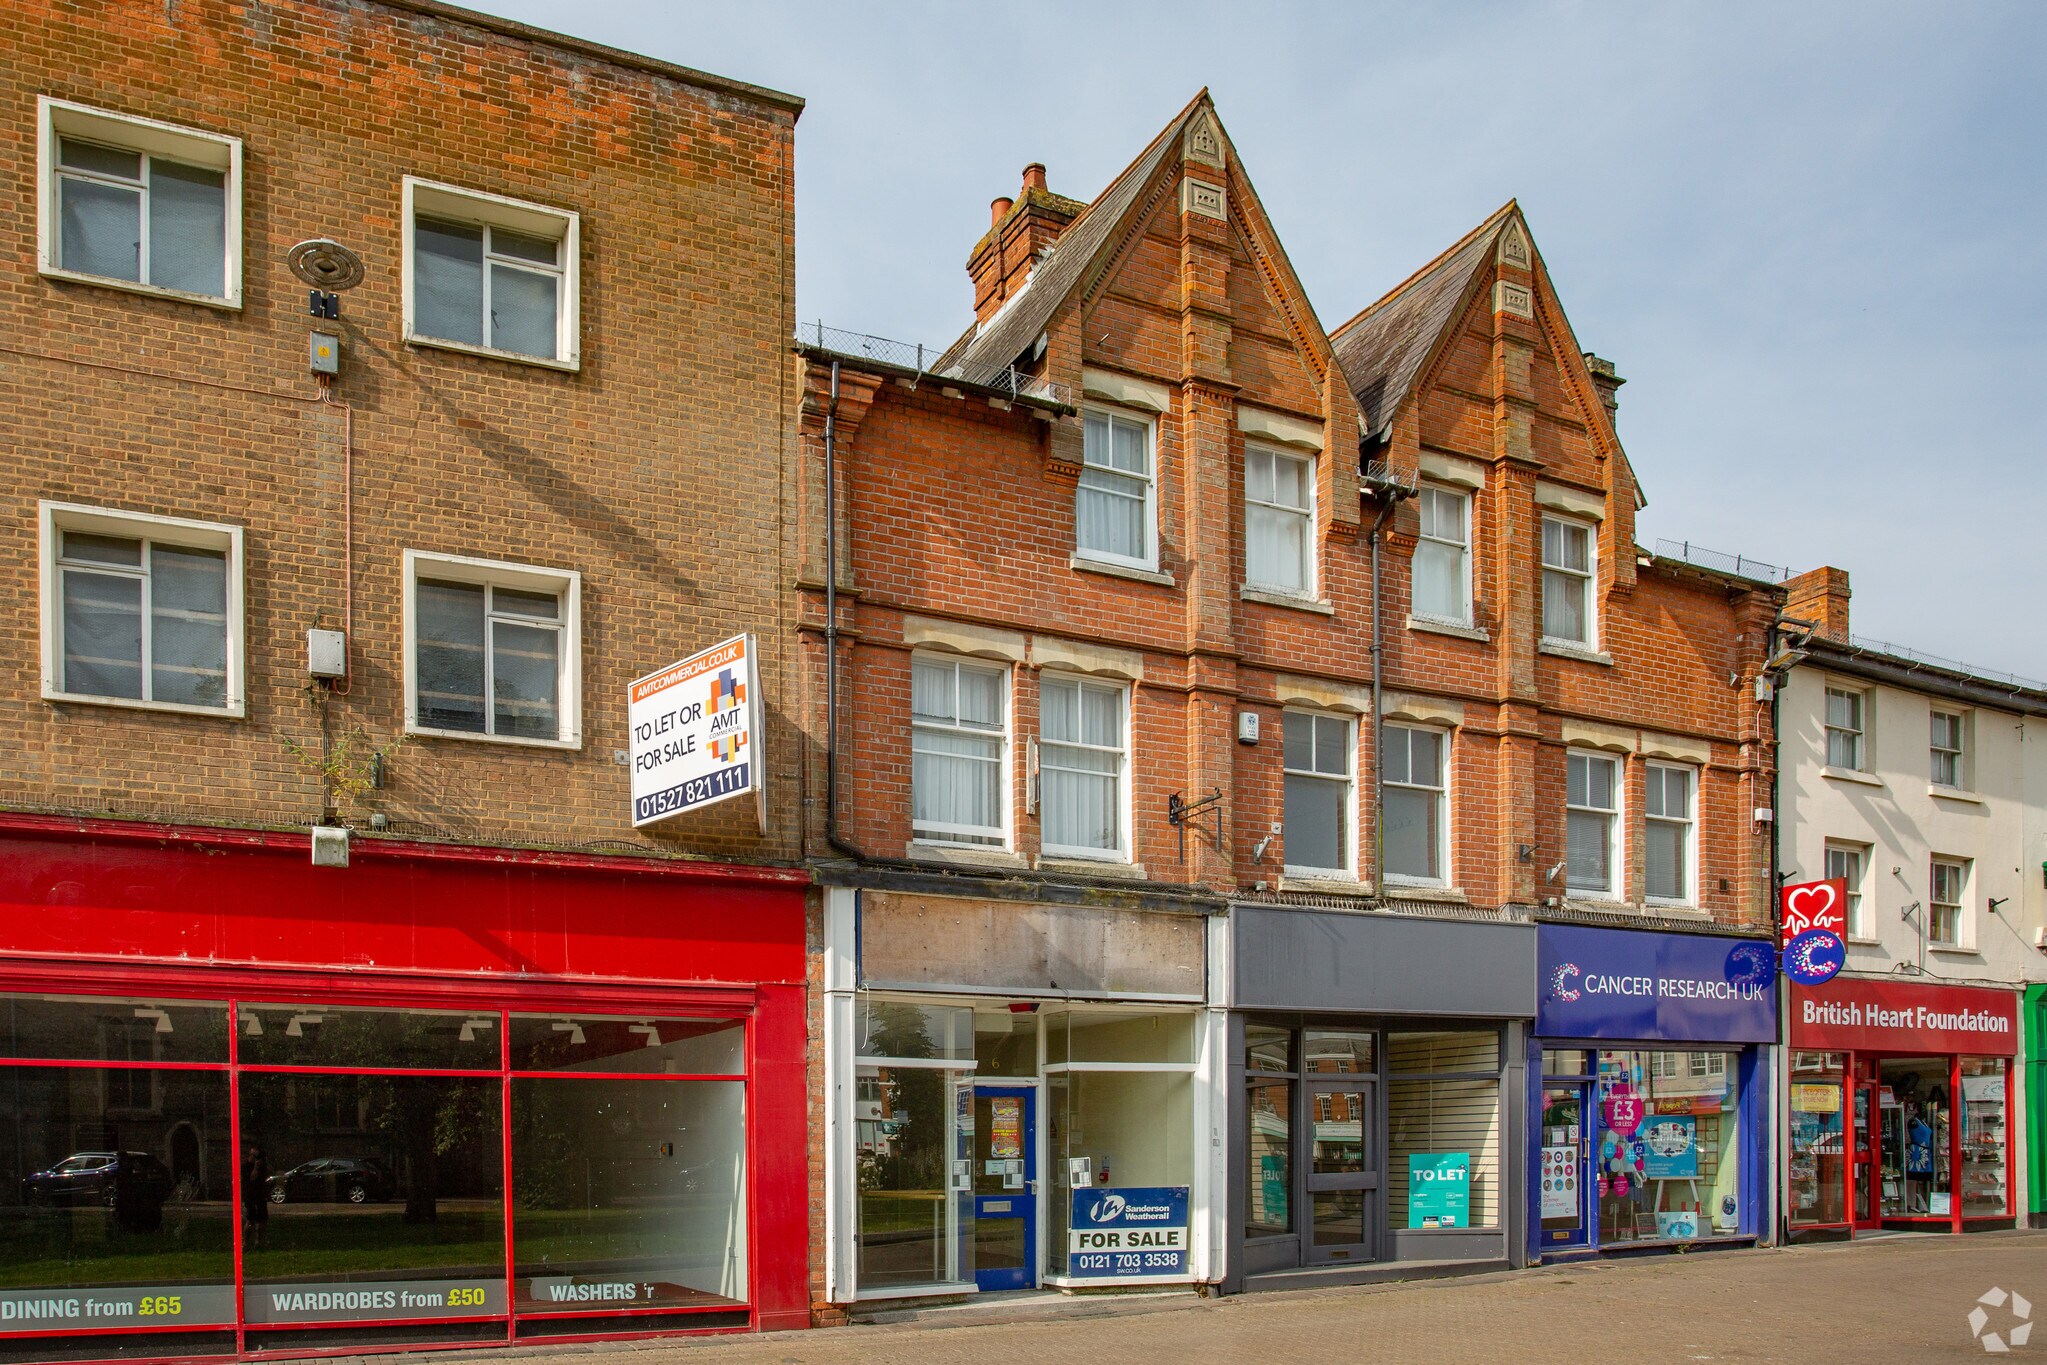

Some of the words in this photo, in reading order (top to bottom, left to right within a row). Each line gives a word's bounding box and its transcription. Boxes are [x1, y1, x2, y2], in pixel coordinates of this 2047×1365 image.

[637, 645, 737, 698] AMTCOMMERCIAL.CO.UK
[635, 722, 652, 744] TO
[654, 711, 677, 736] LET
[680, 702, 701, 725] OR
[709, 725, 742, 739] COMMERCIAL
[710, 708, 741, 732] AMT
[636, 748, 662, 773] FOR
[664, 734, 696, 764] SALE
[640, 785, 684, 818] 01527
[686, 776, 712, 803] 821
[716, 766, 743, 794] 111
[1585, 974, 1652, 996] CANCER
[1659, 978, 1737, 1000] RESEARCH
[1743, 983, 1763, 1001] UK
[1803, 1000, 1861, 1026] British
[1866, 1004, 1913, 1028] Heart
[1917, 1006, 2009, 1033] Foundation
[991, 1058, 999, 1069] 6
[1613, 1101, 1634, 1120] £3
[1413, 1169, 1435, 1181] TO
[1438, 1169, 1466, 1180] LET
[1125, 1212, 1170, 1220] Weatherall
[1080, 1232, 1120, 1248] FOR
[1127, 1231, 1178, 1247] SALE
[1080, 1254, 1110, 1268] 0121
[1116, 1254, 1141, 1267] 703
[1145, 1253, 1178, 1267] 3538
[272, 1290, 396, 1311] WARDROBES
[400, 1290, 443, 1308] from
[447, 1287, 485, 1307] £50
[550, 1282, 637, 1302] WASHERS
[1, 1298, 79, 1320] DINING
[85, 1298, 133, 1317] from
[138, 1296, 182, 1316] £65
